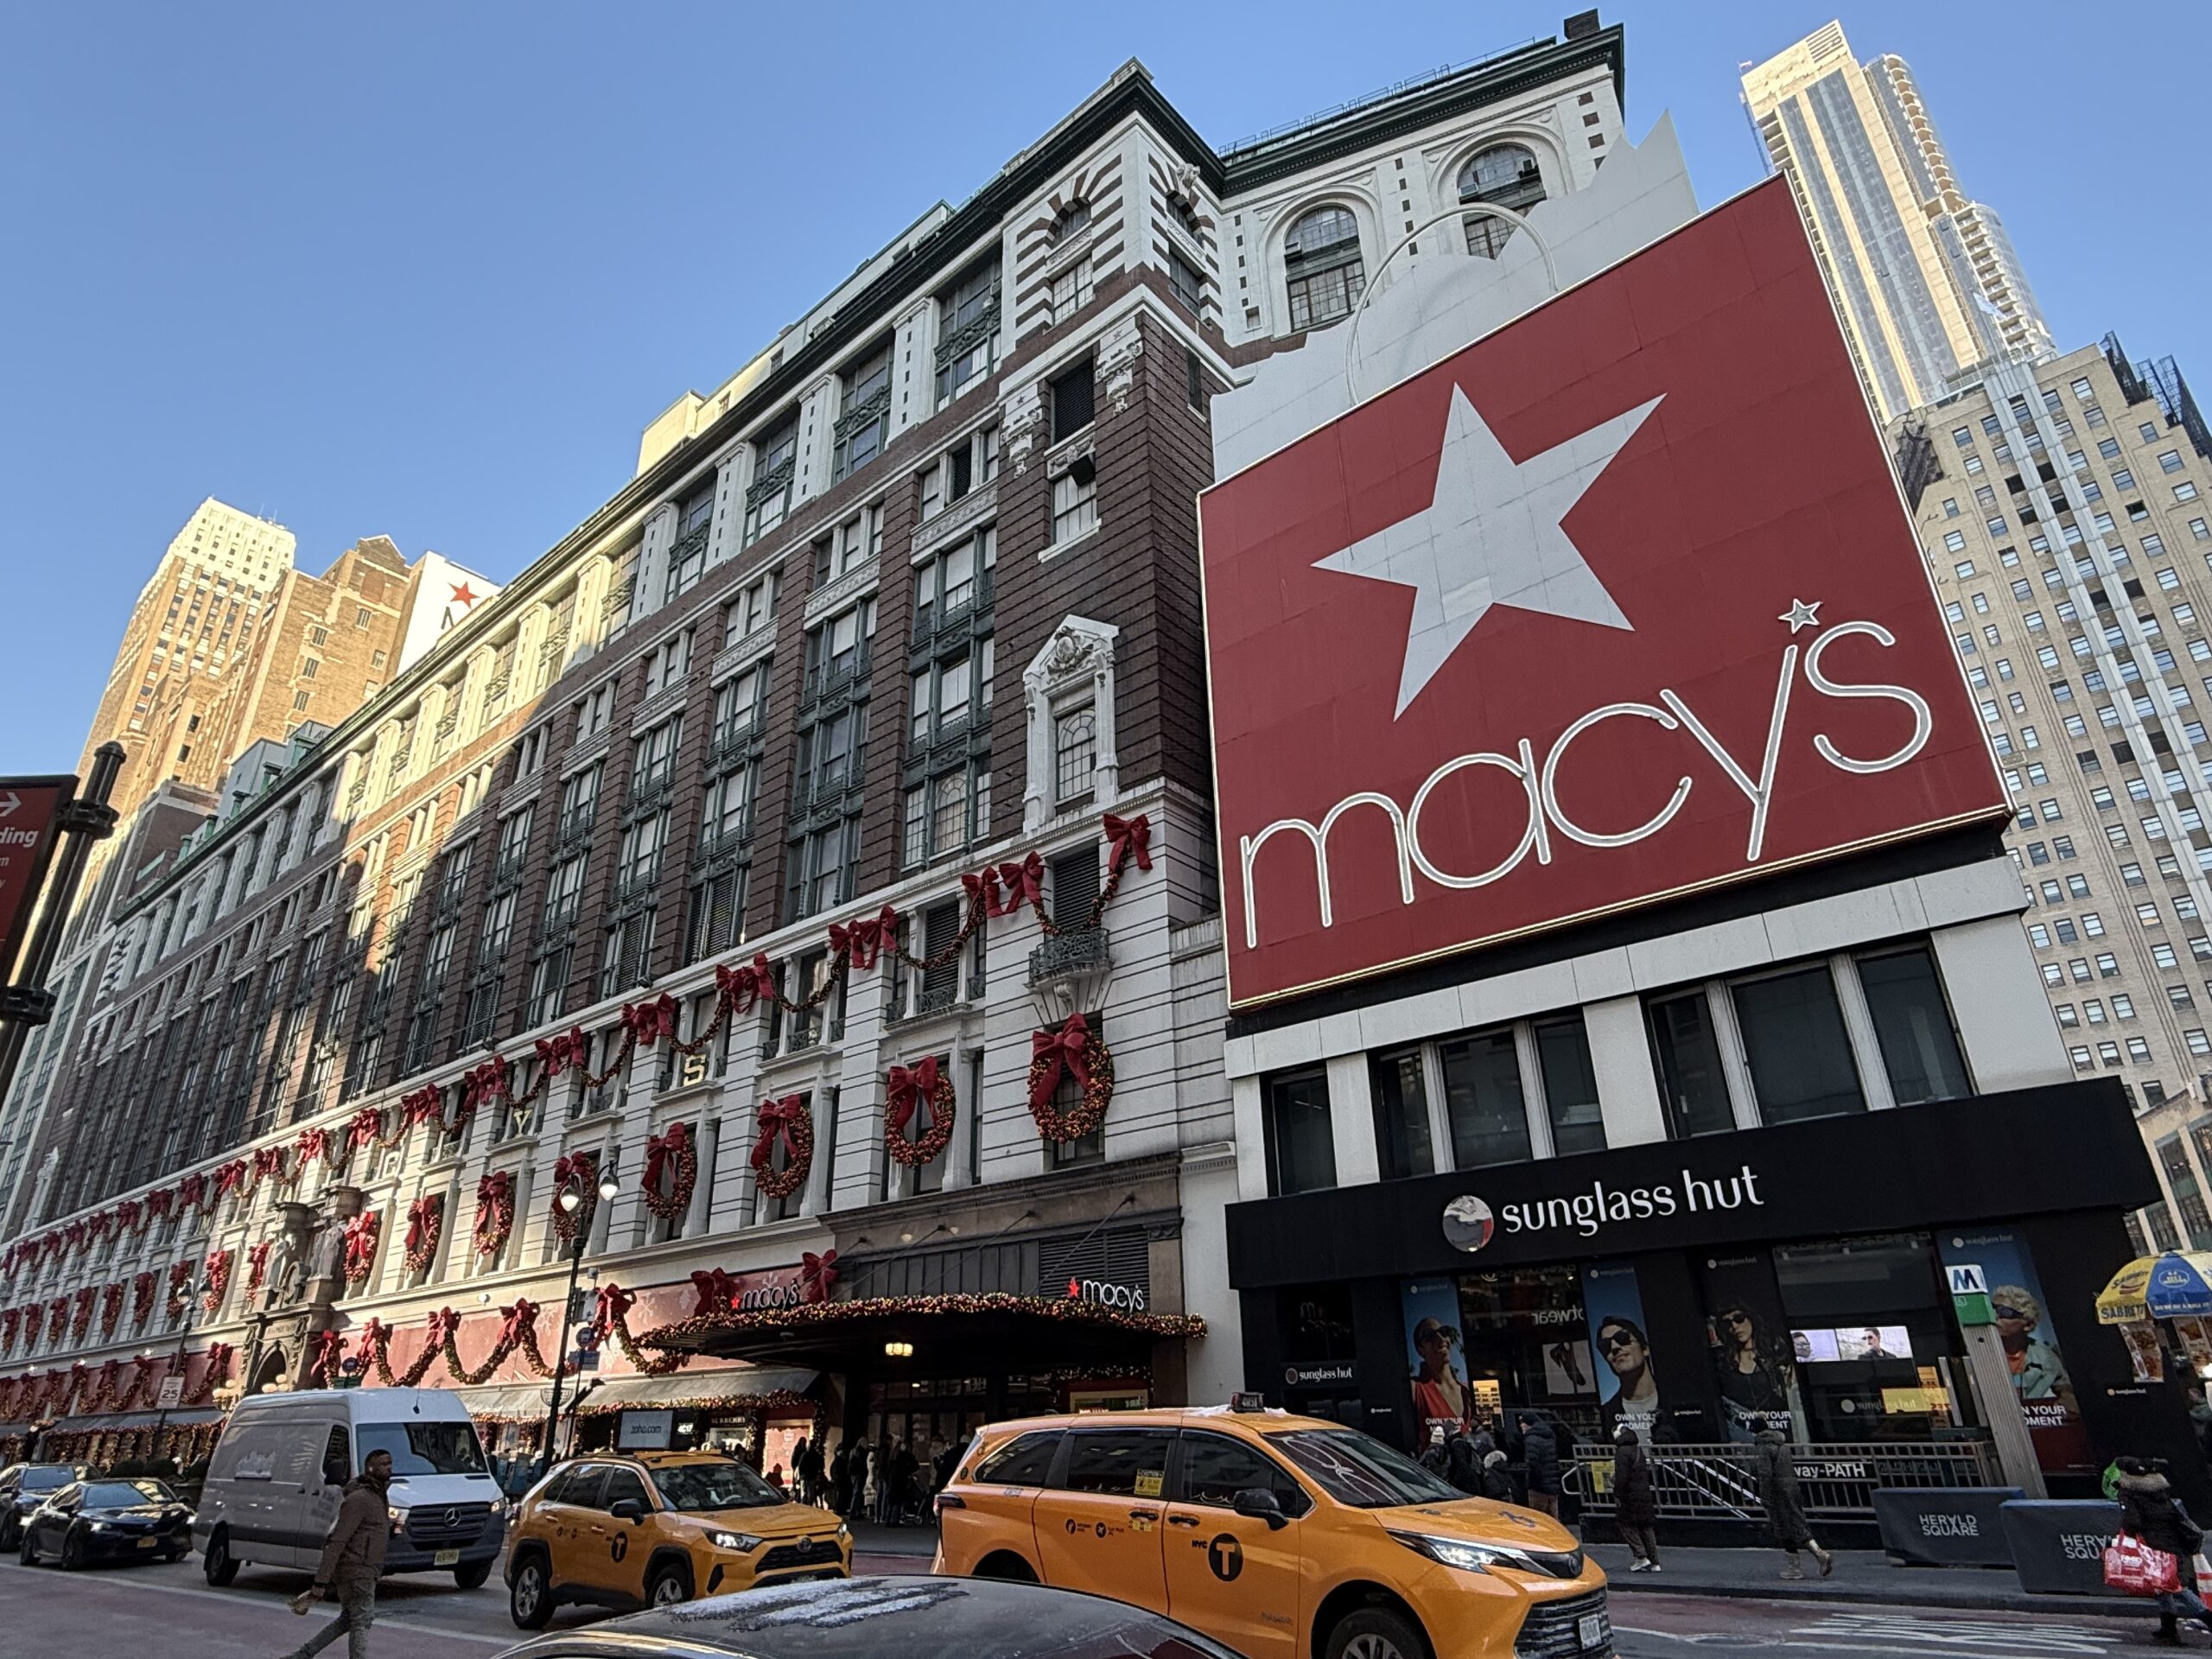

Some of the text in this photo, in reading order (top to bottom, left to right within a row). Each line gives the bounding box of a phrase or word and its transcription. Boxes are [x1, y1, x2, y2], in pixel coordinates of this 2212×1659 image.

[1241, 598, 1933, 949] macy's
[1502, 1166, 1764, 1237] sunglass hut
[741, 1278, 798, 1312] macy's
[1083, 1279, 1145, 1314] macy's
[1299, 1366, 1352, 1382] sunglass hut
[162, 1389, 178, 1399] 25
[2031, 1405, 2067, 1415] YOUR
[1614, 1414, 1636, 1422] OWN
[2025, 1416, 2063, 1426] MENT
[1922, 1524, 1980, 1536] SQUARE
[1191, 1540, 1208, 1548] NYC
[2060, 1534, 2112, 1547] HERA
[2064, 1547, 2101, 1560] SQU
